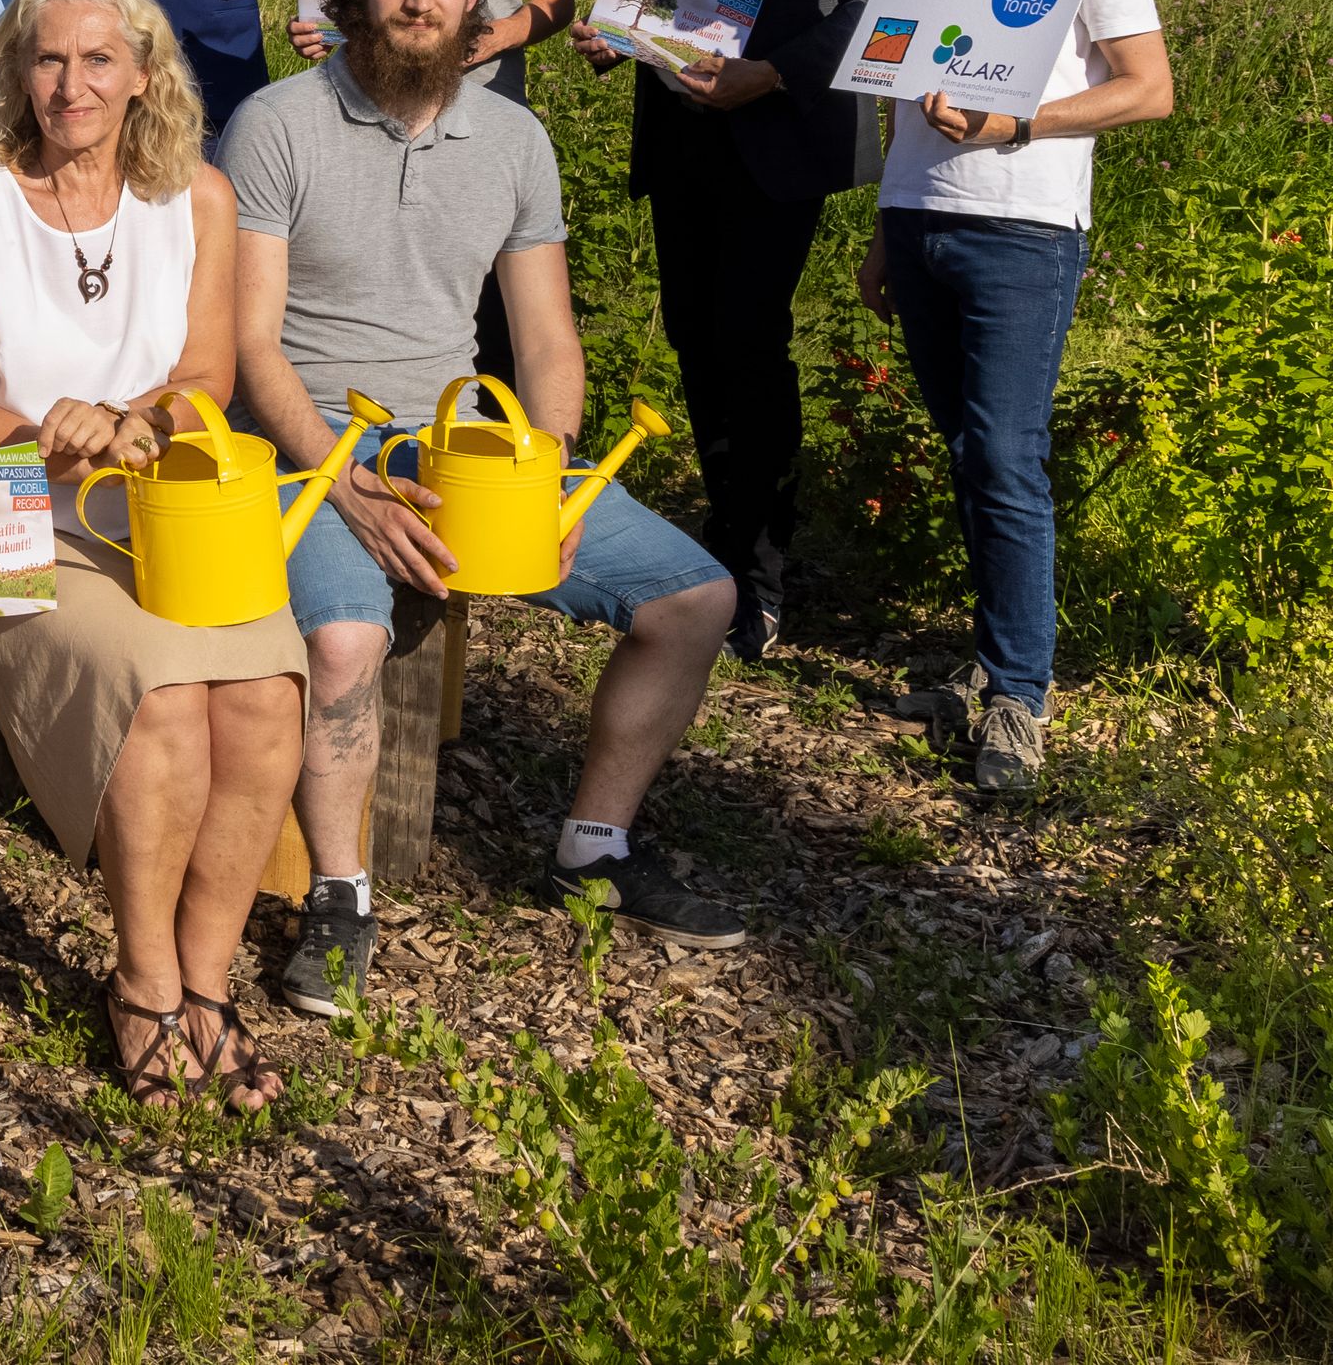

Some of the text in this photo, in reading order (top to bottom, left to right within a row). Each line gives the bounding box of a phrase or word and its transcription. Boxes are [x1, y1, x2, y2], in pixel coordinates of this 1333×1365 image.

[718, 7, 750, 25] REGION
[853, 67, 896, 80] SÜDLICHES
[946, 58, 1014, 82] KLAR!
[851, 75, 893, 87] WEINVIERTEL
[940, 78, 1031, 98] KlimawandelAnpassungs
[12, 483, 45, 494] MODELL-
[16, 498, 46, 509] REGION
[17, 522, 25, 534] in
[575, 824, 613, 837] PUMA
